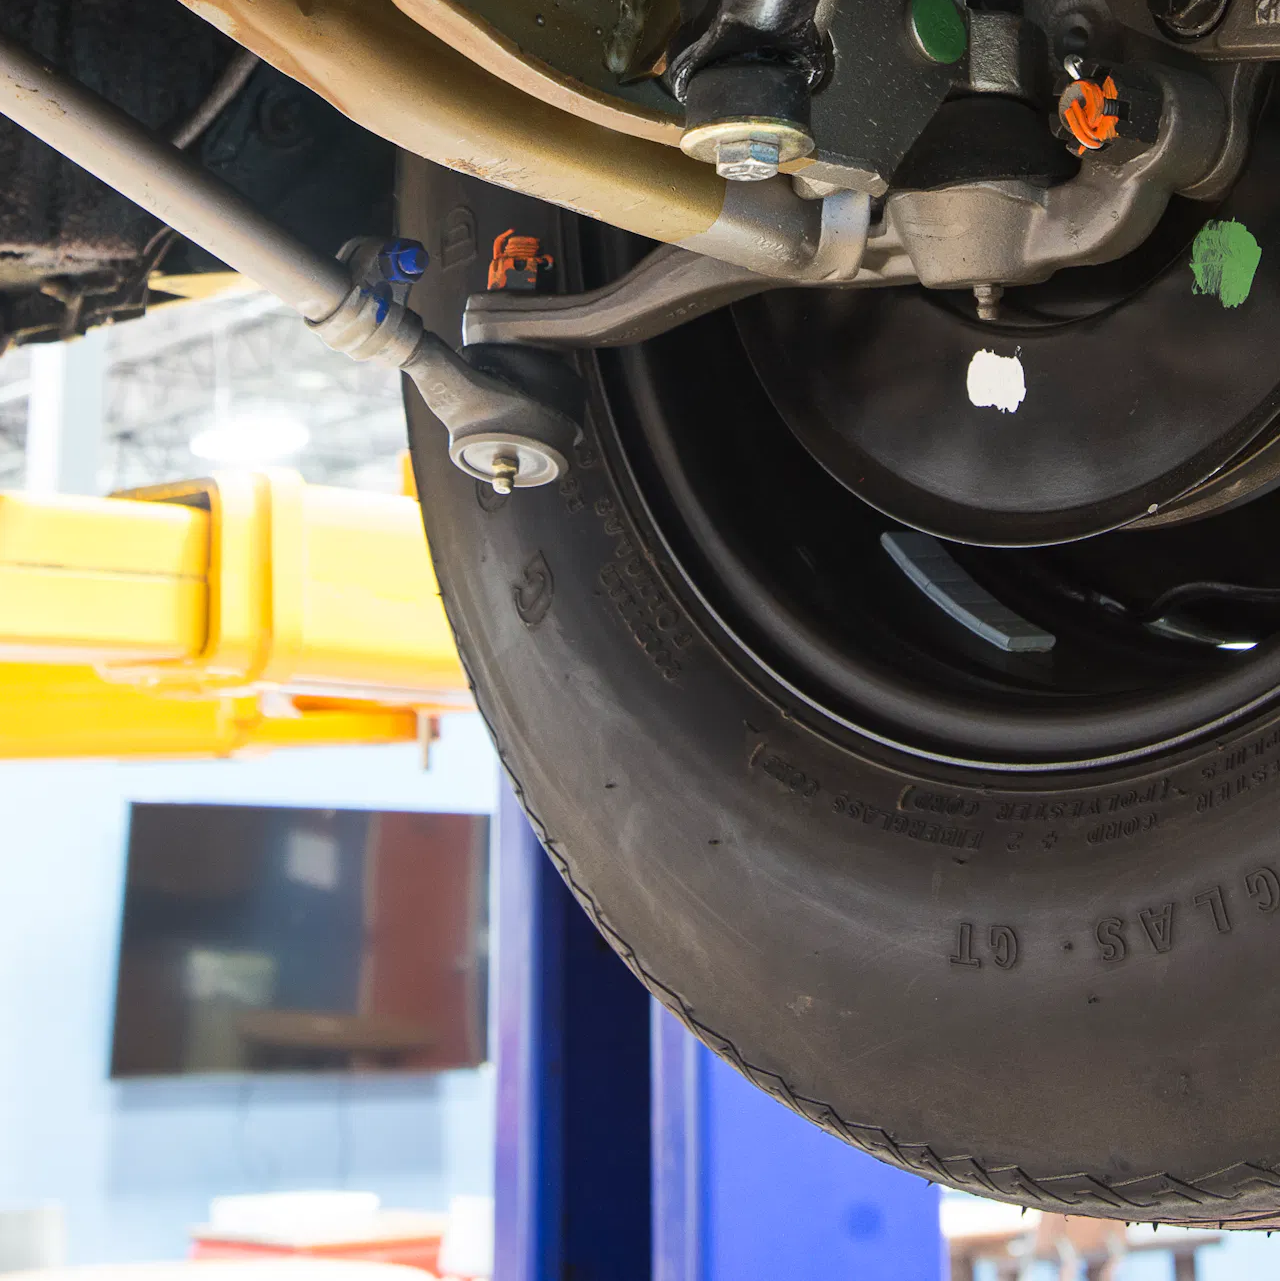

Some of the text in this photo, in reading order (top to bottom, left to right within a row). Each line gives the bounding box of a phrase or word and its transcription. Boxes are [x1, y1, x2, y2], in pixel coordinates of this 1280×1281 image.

[829, 791, 985, 850] FIBERGLASS
[1005, 831, 1022, 852] 2
[1085, 808, 1159, 846] CORD
[949, 921, 1020, 971] GT
